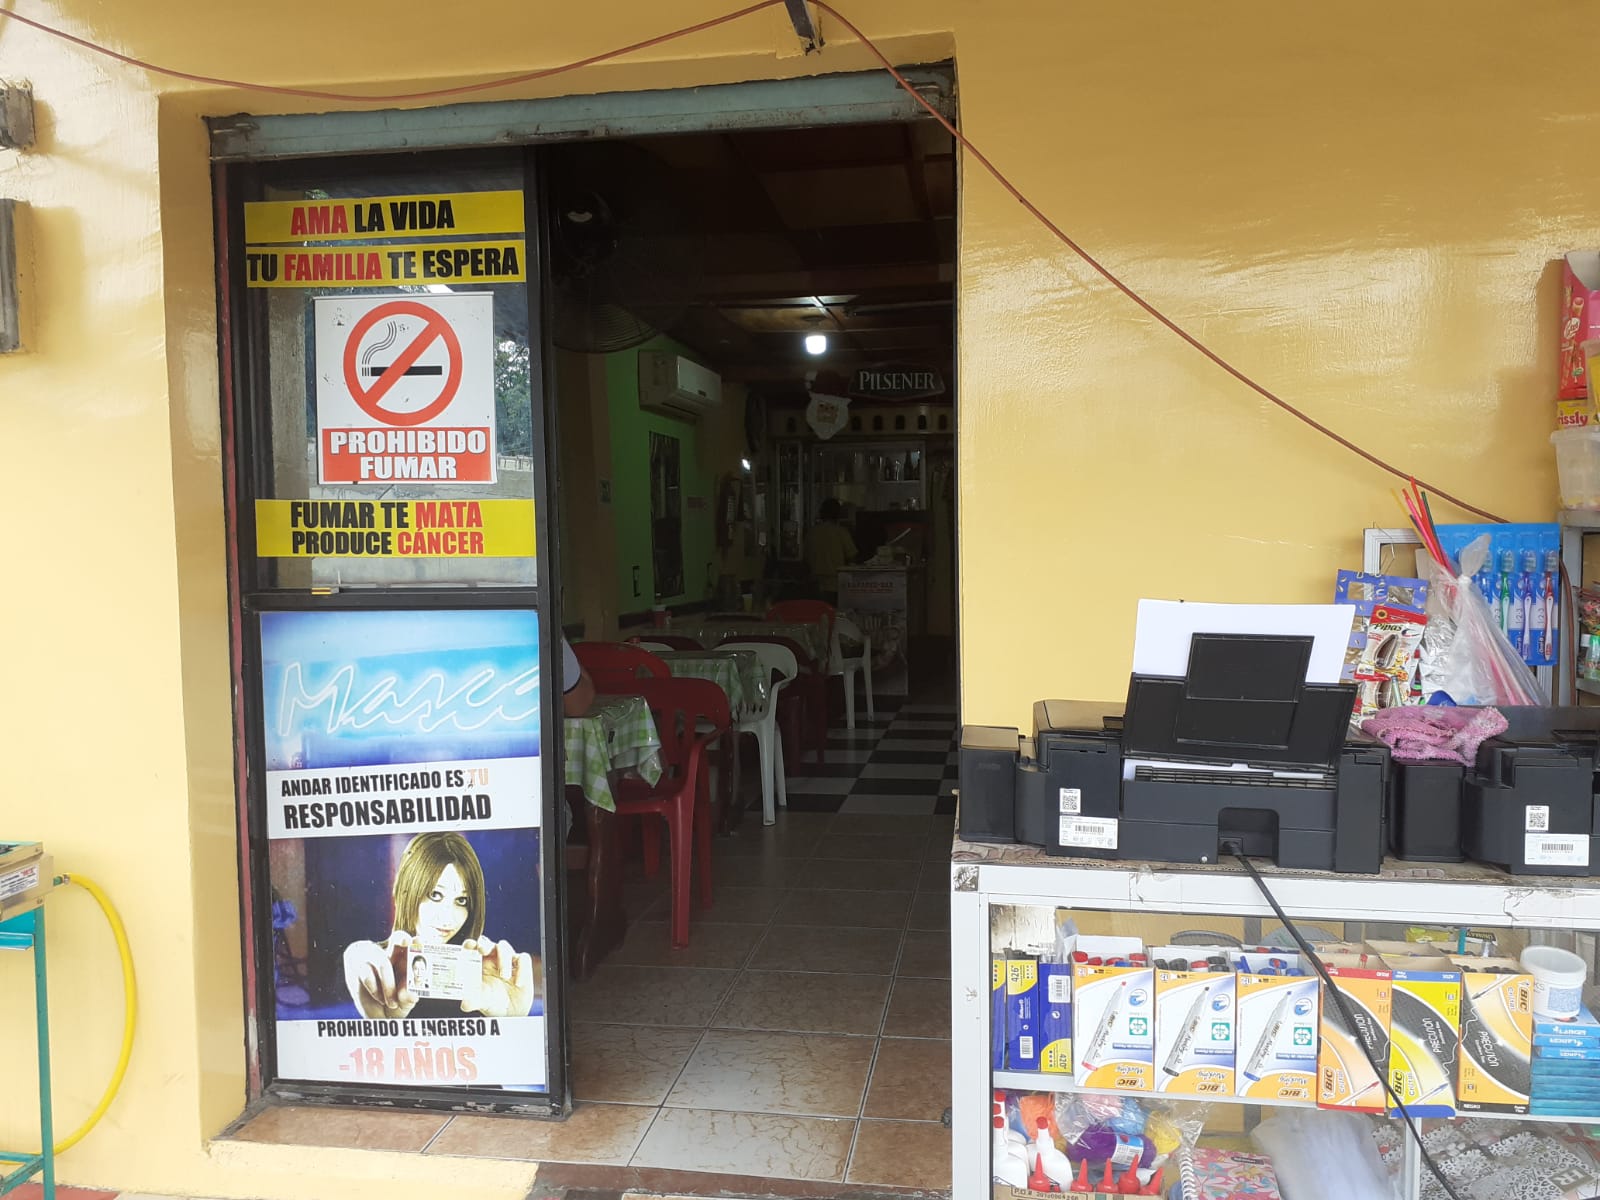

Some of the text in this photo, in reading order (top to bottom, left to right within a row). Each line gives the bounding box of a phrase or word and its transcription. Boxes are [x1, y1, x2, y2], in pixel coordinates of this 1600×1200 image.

[290, 200, 455, 236] AMA LA VIDA
[247, 247, 519, 282] TU FAMILIA TE ESPERA
[858, 371, 936, 391] PILSENER
[330, 429, 486, 455] PROHIBIDO
[360, 456, 457, 480] FUMAR
[290, 501, 483, 529] FUMAR TE MATA
[292, 523, 484, 555] PRODUCE CÁNCER
[1373, 622, 1403, 632] Pipas
[281, 768, 489, 797] ANDAR IDENTIFICADO ES TU
[283, 793, 492, 831] RESPONSABILIDAD
[1519, 988, 1528, 1011] BIC
[317, 1020, 501, 1038] PROHIBIDO EL INGRESO A
[394, 1041, 478, 1082] AÑOS
[1117, 1078, 1138, 1086] BIC
[1199, 1083, 1220, 1092] BIC
[1324, 1069, 1334, 1091] BIC
[1394, 1071, 1404, 1095] BIC
[1280, 1089, 1301, 1097] BIC
